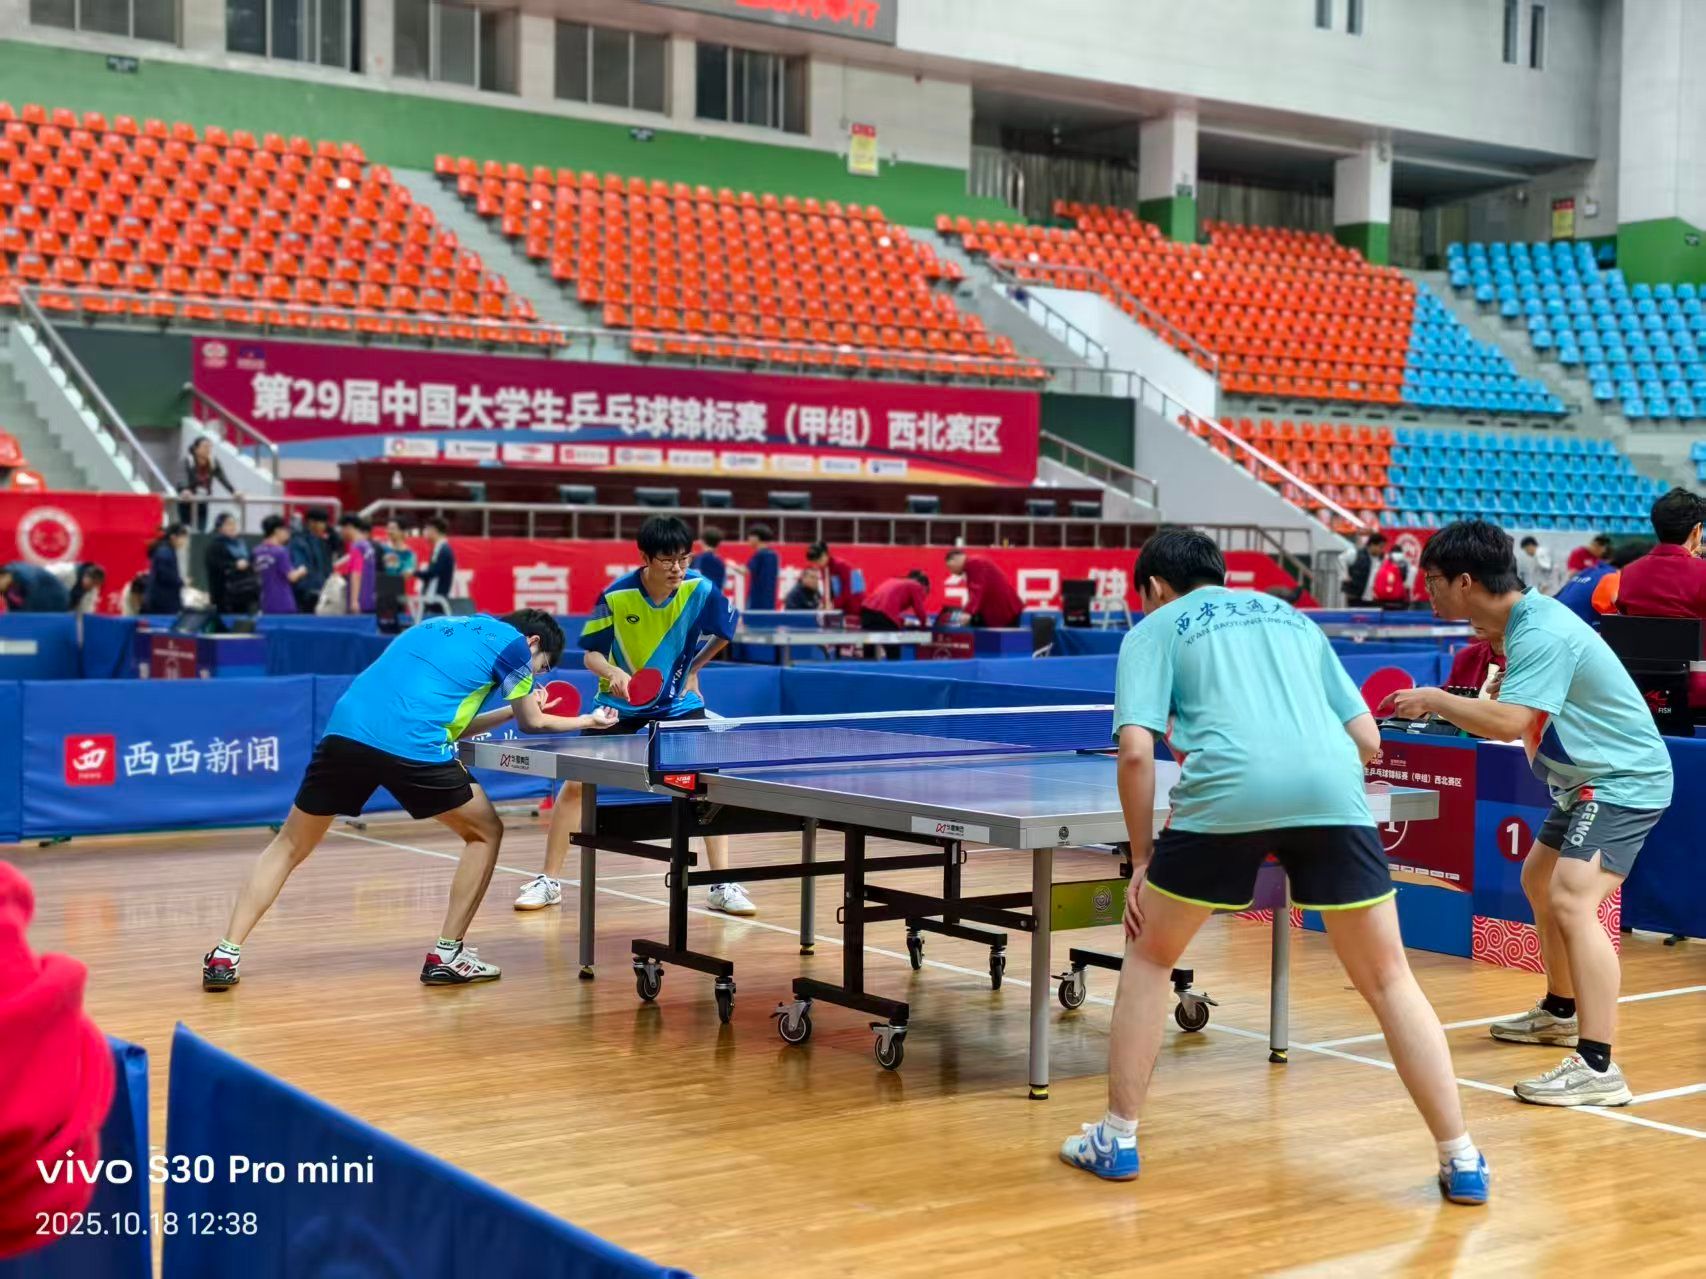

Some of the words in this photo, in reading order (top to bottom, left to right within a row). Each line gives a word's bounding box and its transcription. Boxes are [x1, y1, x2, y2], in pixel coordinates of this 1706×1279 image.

[1174, 598, 1306, 636] 西安交通大
[123, 736, 280, 777] 西西新闻
[1506, 822, 1520, 855] 1
